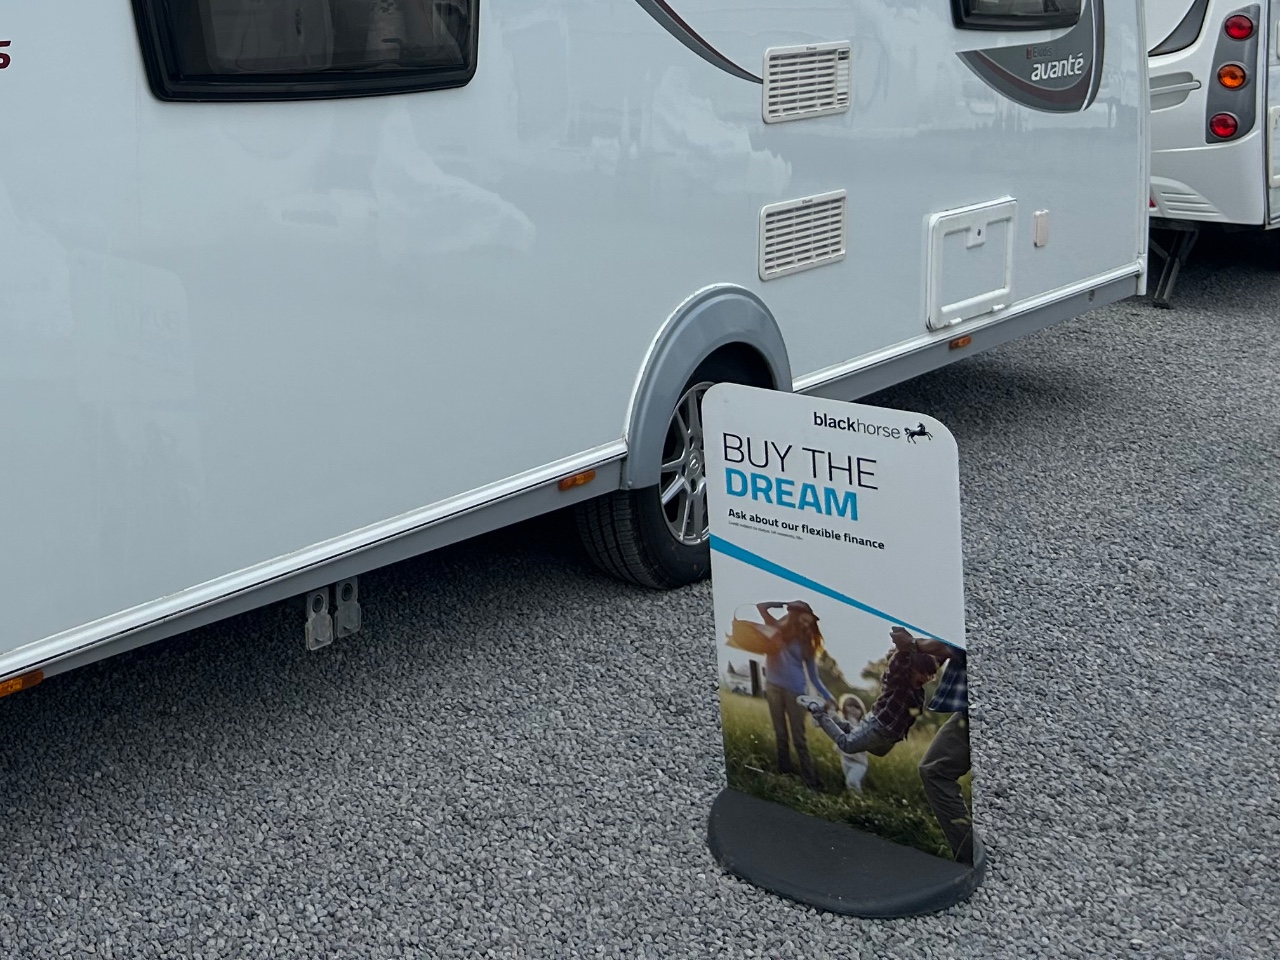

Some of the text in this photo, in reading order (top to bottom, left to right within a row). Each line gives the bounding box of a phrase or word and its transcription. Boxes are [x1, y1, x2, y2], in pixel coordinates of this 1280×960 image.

[1030, 52, 1084, 81] avanté
[813, 411, 901, 439] blackhorse
[722, 432, 879, 490] BUY THE
[725, 467, 859, 521] DREAM
[728, 508, 747, 521] Ask
[749, 513, 779, 528] about
[781, 521, 799, 532] our
[801, 524, 842, 541] flexible
[843, 532, 885, 550] finance
